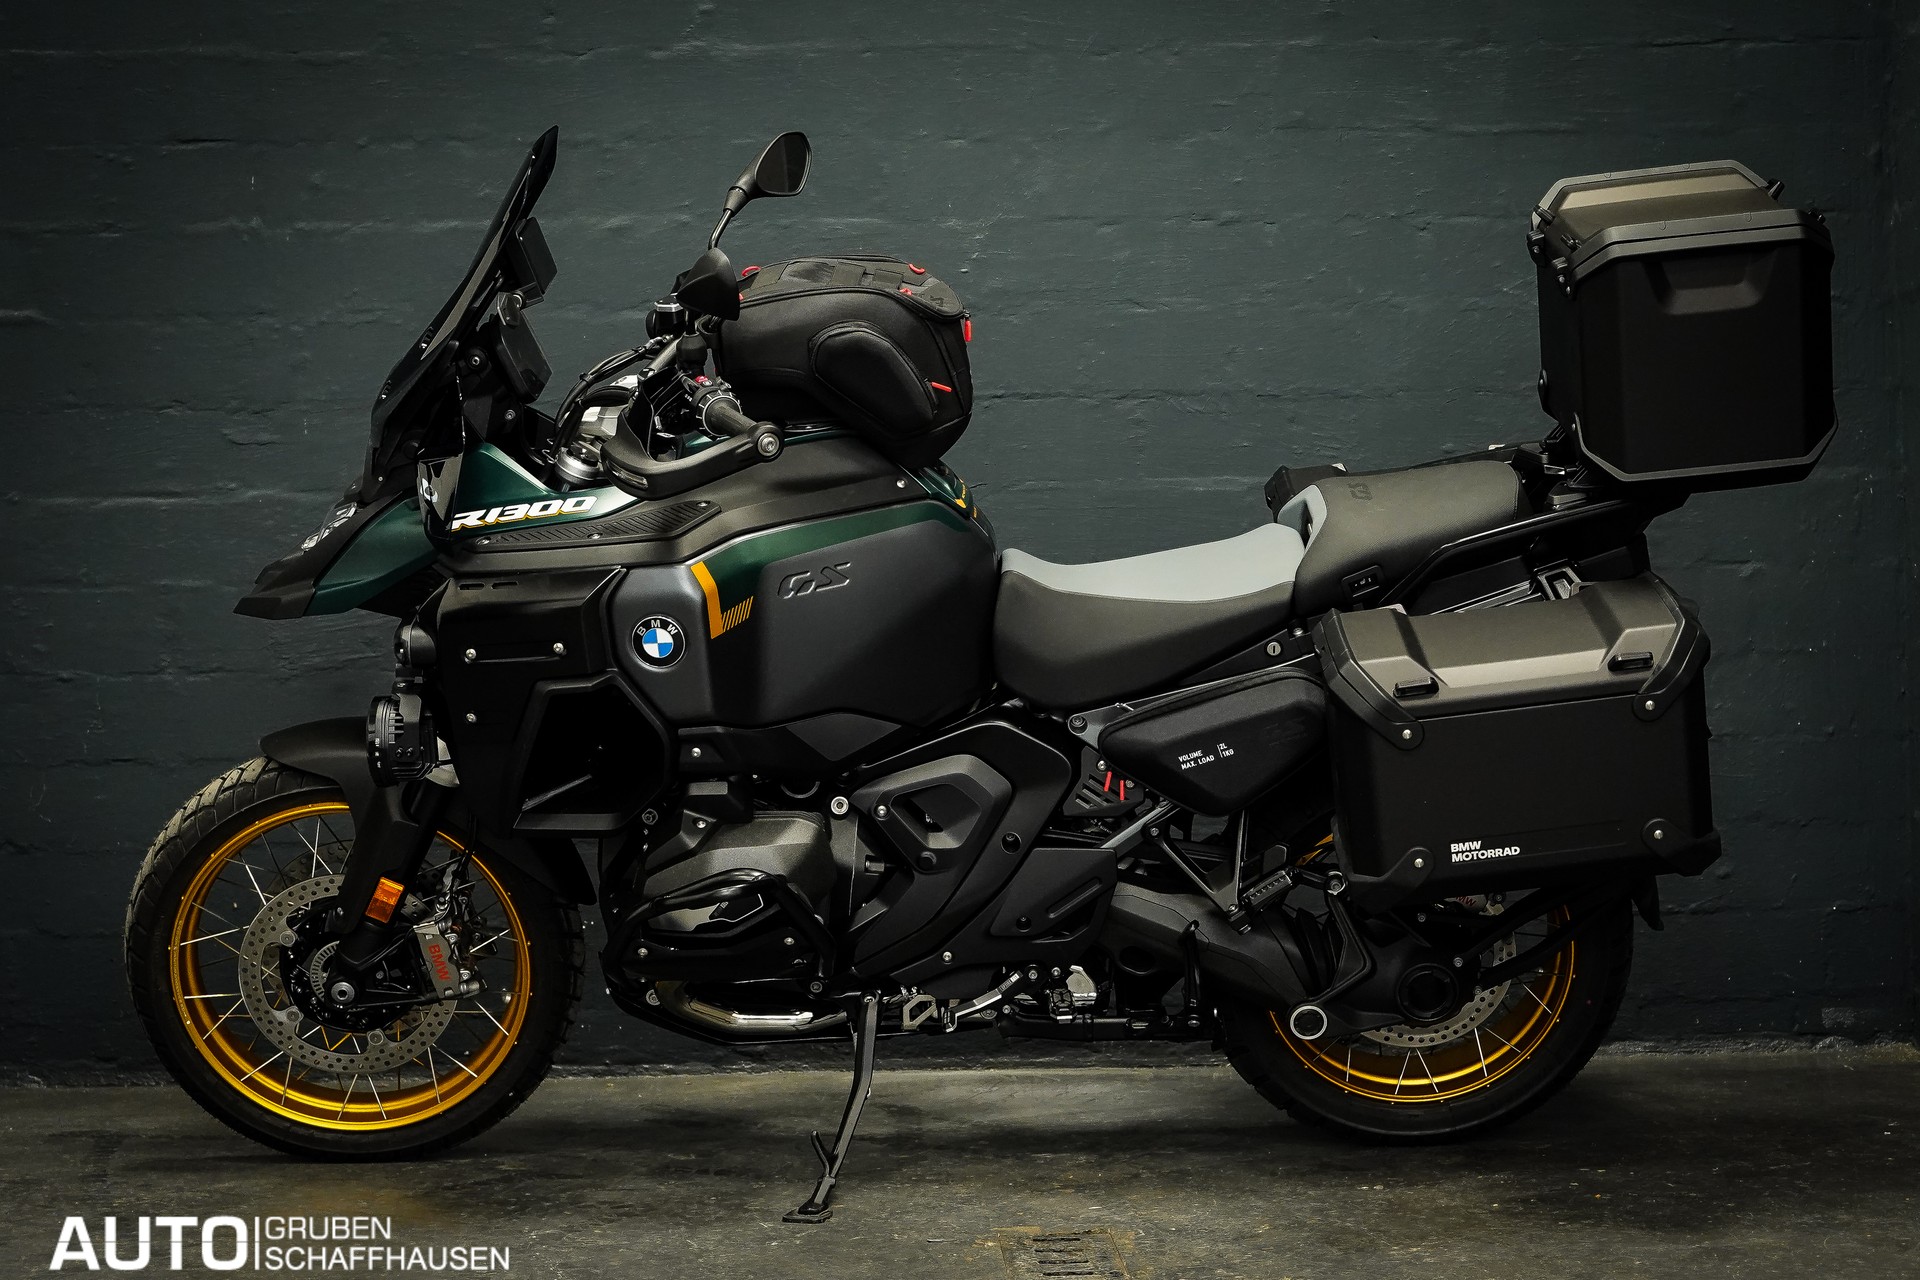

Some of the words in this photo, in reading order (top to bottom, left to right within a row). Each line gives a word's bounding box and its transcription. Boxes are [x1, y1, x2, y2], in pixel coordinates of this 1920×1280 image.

[451, 496, 598, 532] R1300
[778, 562, 851, 599] GS
[636, 619, 679, 636] BMW
[1178, 750, 1203, 762] VOLUME
[1181, 760, 1197, 770] MAX.
[1198, 754, 1215, 765] LOAD
[1450, 840, 1482, 852] BMW
[1451, 846, 1521, 862] MOTORRAD
[428, 944, 452, 980] BMW
